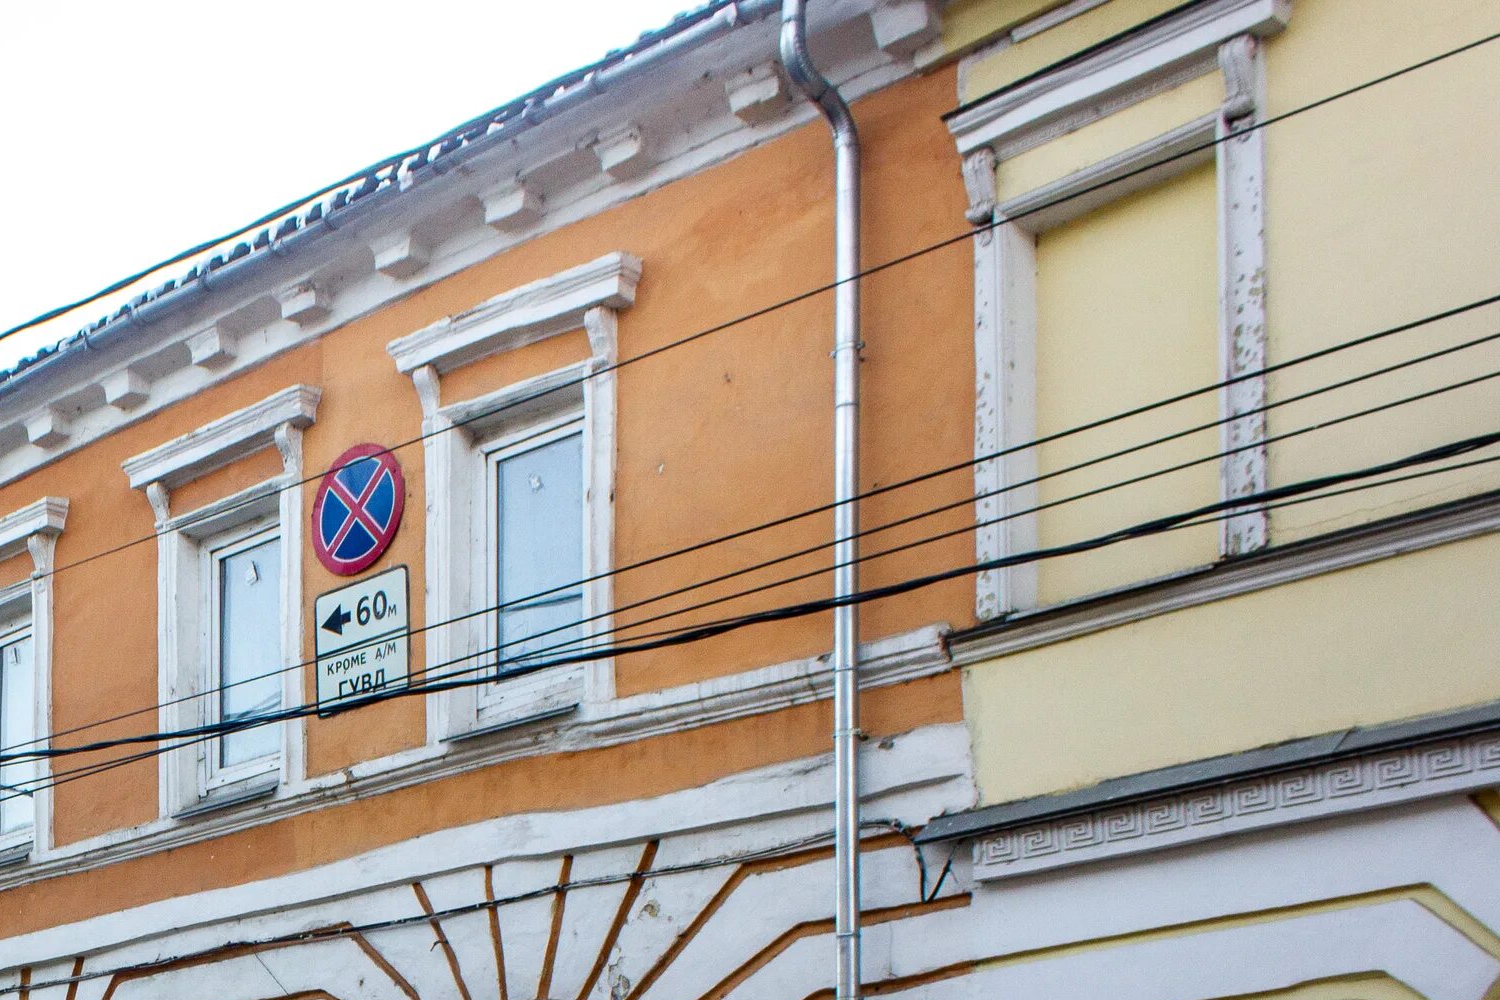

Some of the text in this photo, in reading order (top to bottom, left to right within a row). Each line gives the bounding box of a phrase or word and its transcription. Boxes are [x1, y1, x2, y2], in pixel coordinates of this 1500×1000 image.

[327, 641, 397, 676] КРОМЕ А/М
[338, 668, 387, 701] ГУВД
